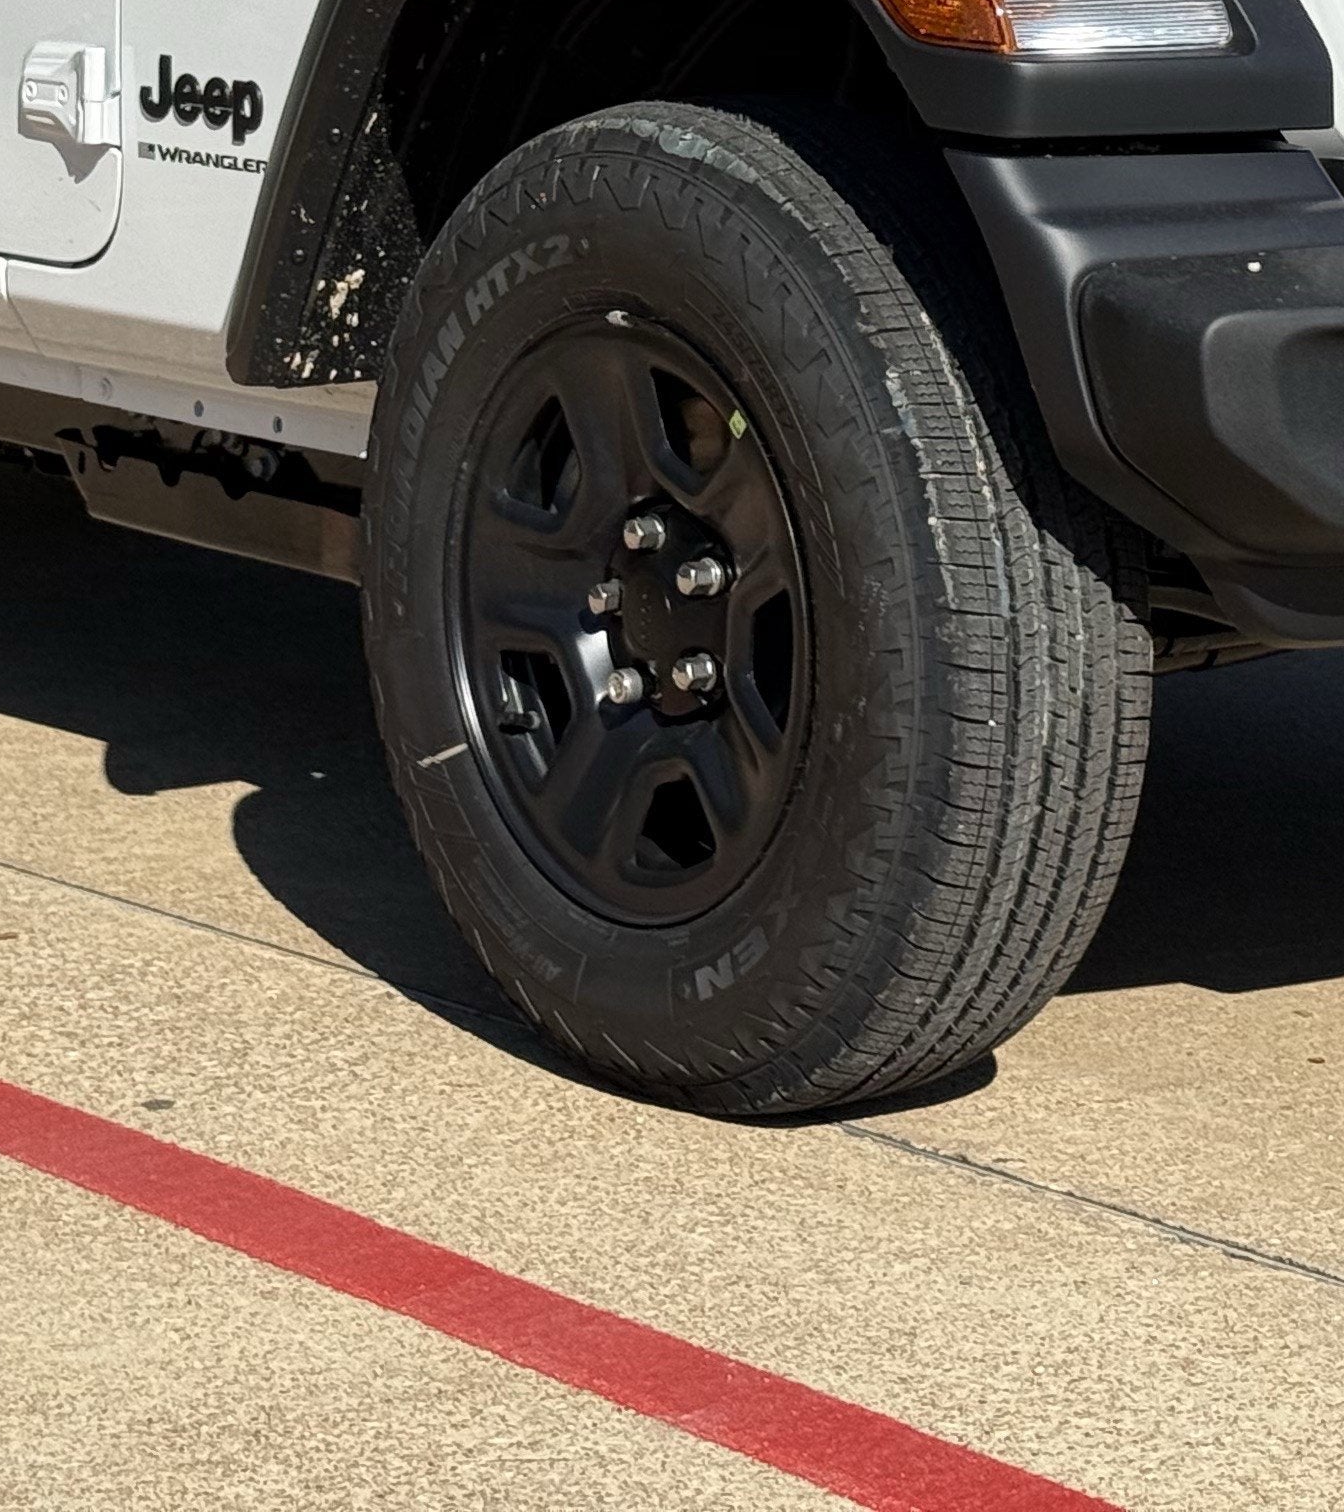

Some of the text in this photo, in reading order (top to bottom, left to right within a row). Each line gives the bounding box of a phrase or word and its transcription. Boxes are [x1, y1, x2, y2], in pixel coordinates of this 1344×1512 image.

[139, 54, 264, 147] Jeep
[157, 144, 268, 174] WRANGLER
[464, 233, 574, 326] HTX2
